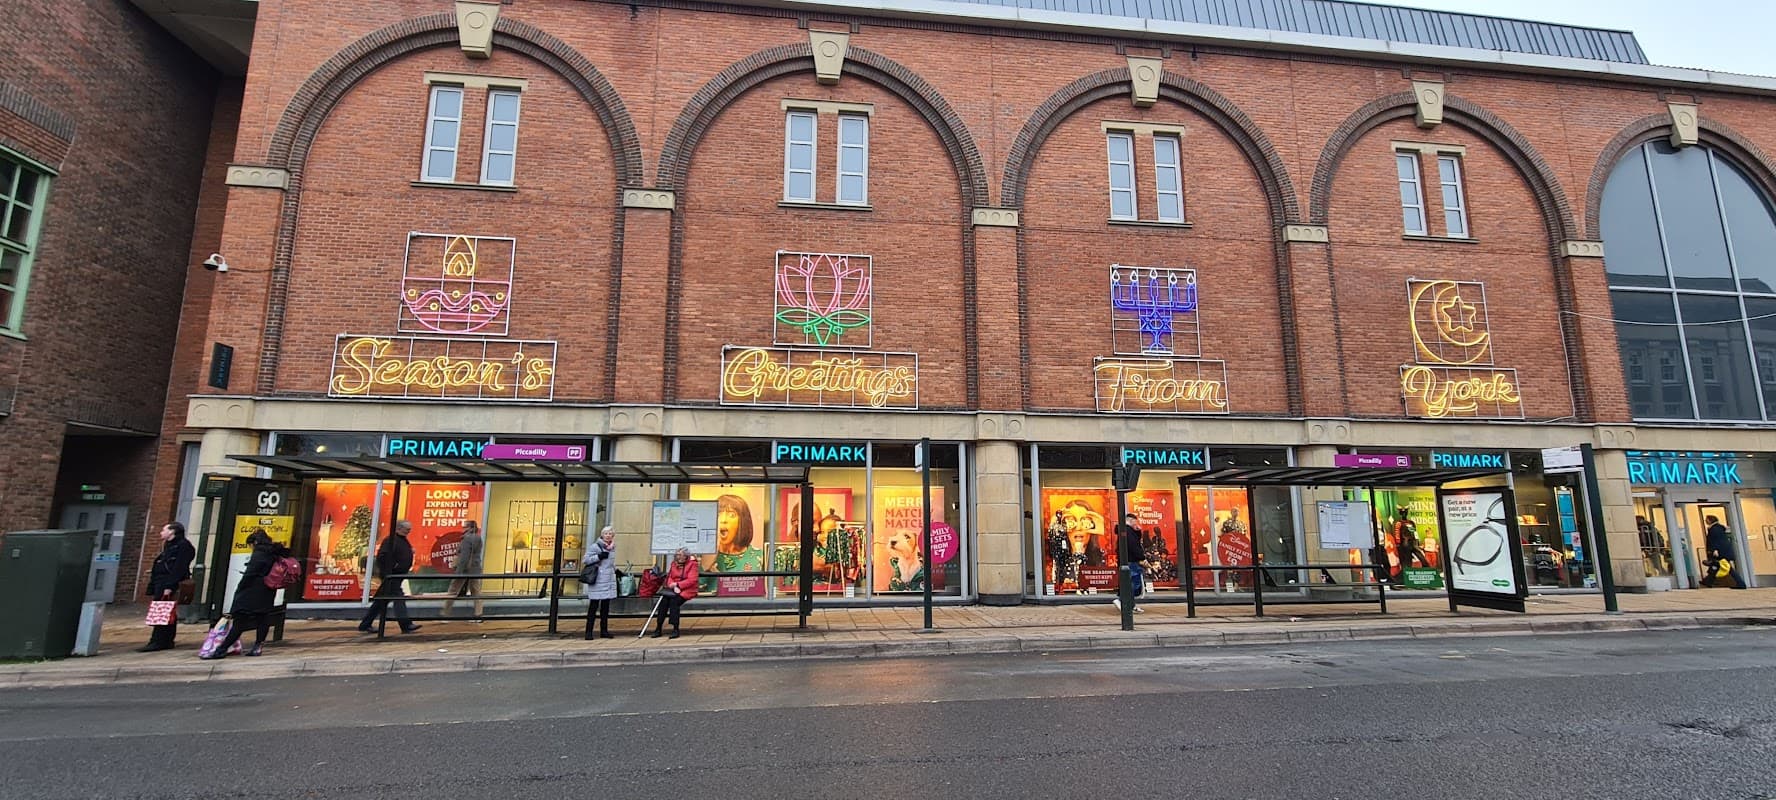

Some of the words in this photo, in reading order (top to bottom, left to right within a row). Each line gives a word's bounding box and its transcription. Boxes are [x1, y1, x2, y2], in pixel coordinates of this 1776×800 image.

[332, 337, 552, 394] Season's
[723, 348, 916, 407] Greetings
[1094, 359, 1226, 412] From
[1403, 365, 1520, 418] York
[389, 439, 489, 457] PRIMARK
[514, 448, 547, 456] Piccadilly
[777, 445, 866, 461] PRIMARK
[1124, 449, 1204, 465] PRIMARK
[1433, 454, 1504, 467] PRIMARK
[1627, 461, 1742, 484] RIMARK
[257, 490, 280, 508] GO
[426, 490, 470, 499] LOOKS
[423, 509, 454, 518] EVEN
[457, 509, 468, 518] IF
[1139, 511, 1163, 520] Family
[422, 518, 434, 527] IT
[934, 533, 952, 543] SETS
[1225, 550, 1243, 561] FROM
